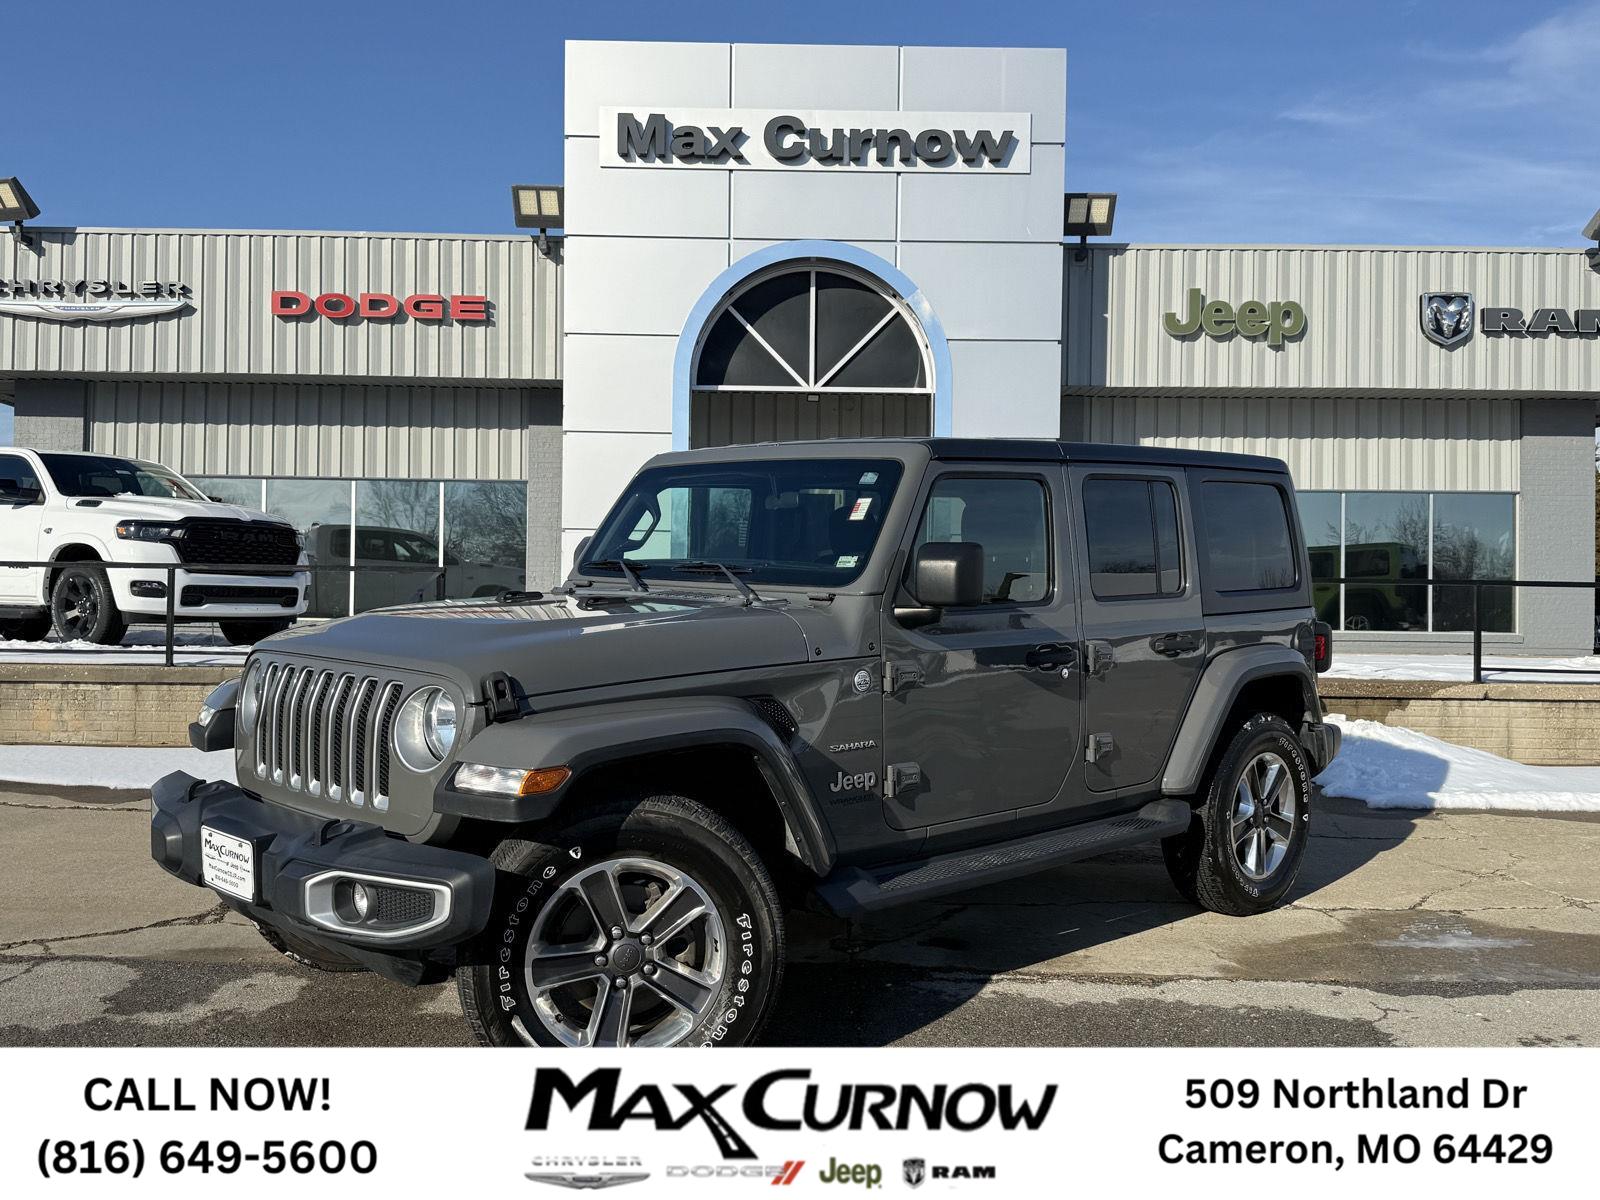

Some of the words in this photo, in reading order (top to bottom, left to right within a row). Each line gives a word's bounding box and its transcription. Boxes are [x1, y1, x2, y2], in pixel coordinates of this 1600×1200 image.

[615, 112, 745, 161] Max
[763, 115, 1015, 164] Curnow
[271, 290, 487, 320] DODGE
[1162, 288, 1306, 346] Jeep
[829, 739, 877, 753] SAHARA
[829, 771, 877, 793] Jeep
[498, 866, 557, 1012] Firestone
